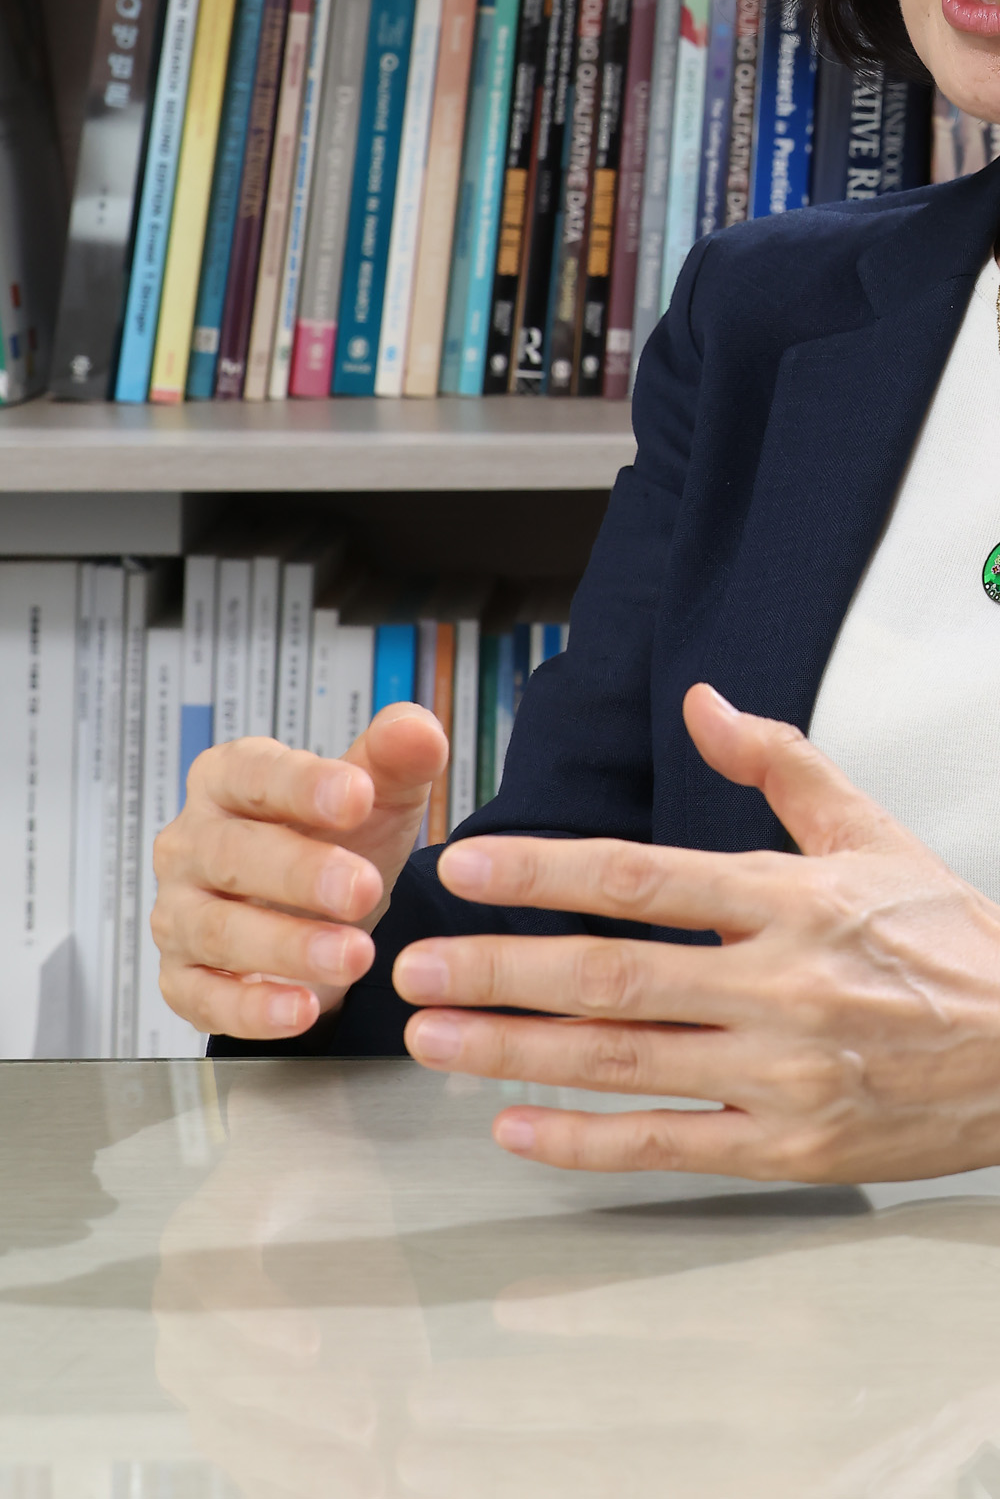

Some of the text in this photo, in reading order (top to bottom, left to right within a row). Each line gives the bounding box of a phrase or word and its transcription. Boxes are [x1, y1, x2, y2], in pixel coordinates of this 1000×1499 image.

[166, 16, 189, 93] RESEARCH
[775, 33, 802, 116] Research
[158, 98, 178, 156] SECOND
[568, 63, 597, 185] QUALITATIVE
[728, 64, 757, 189] QUALITATIVE
[149, 161, 170, 218] EDITION
[366, 135, 388, 192] METHODS
[562, 191, 586, 243] DATA
